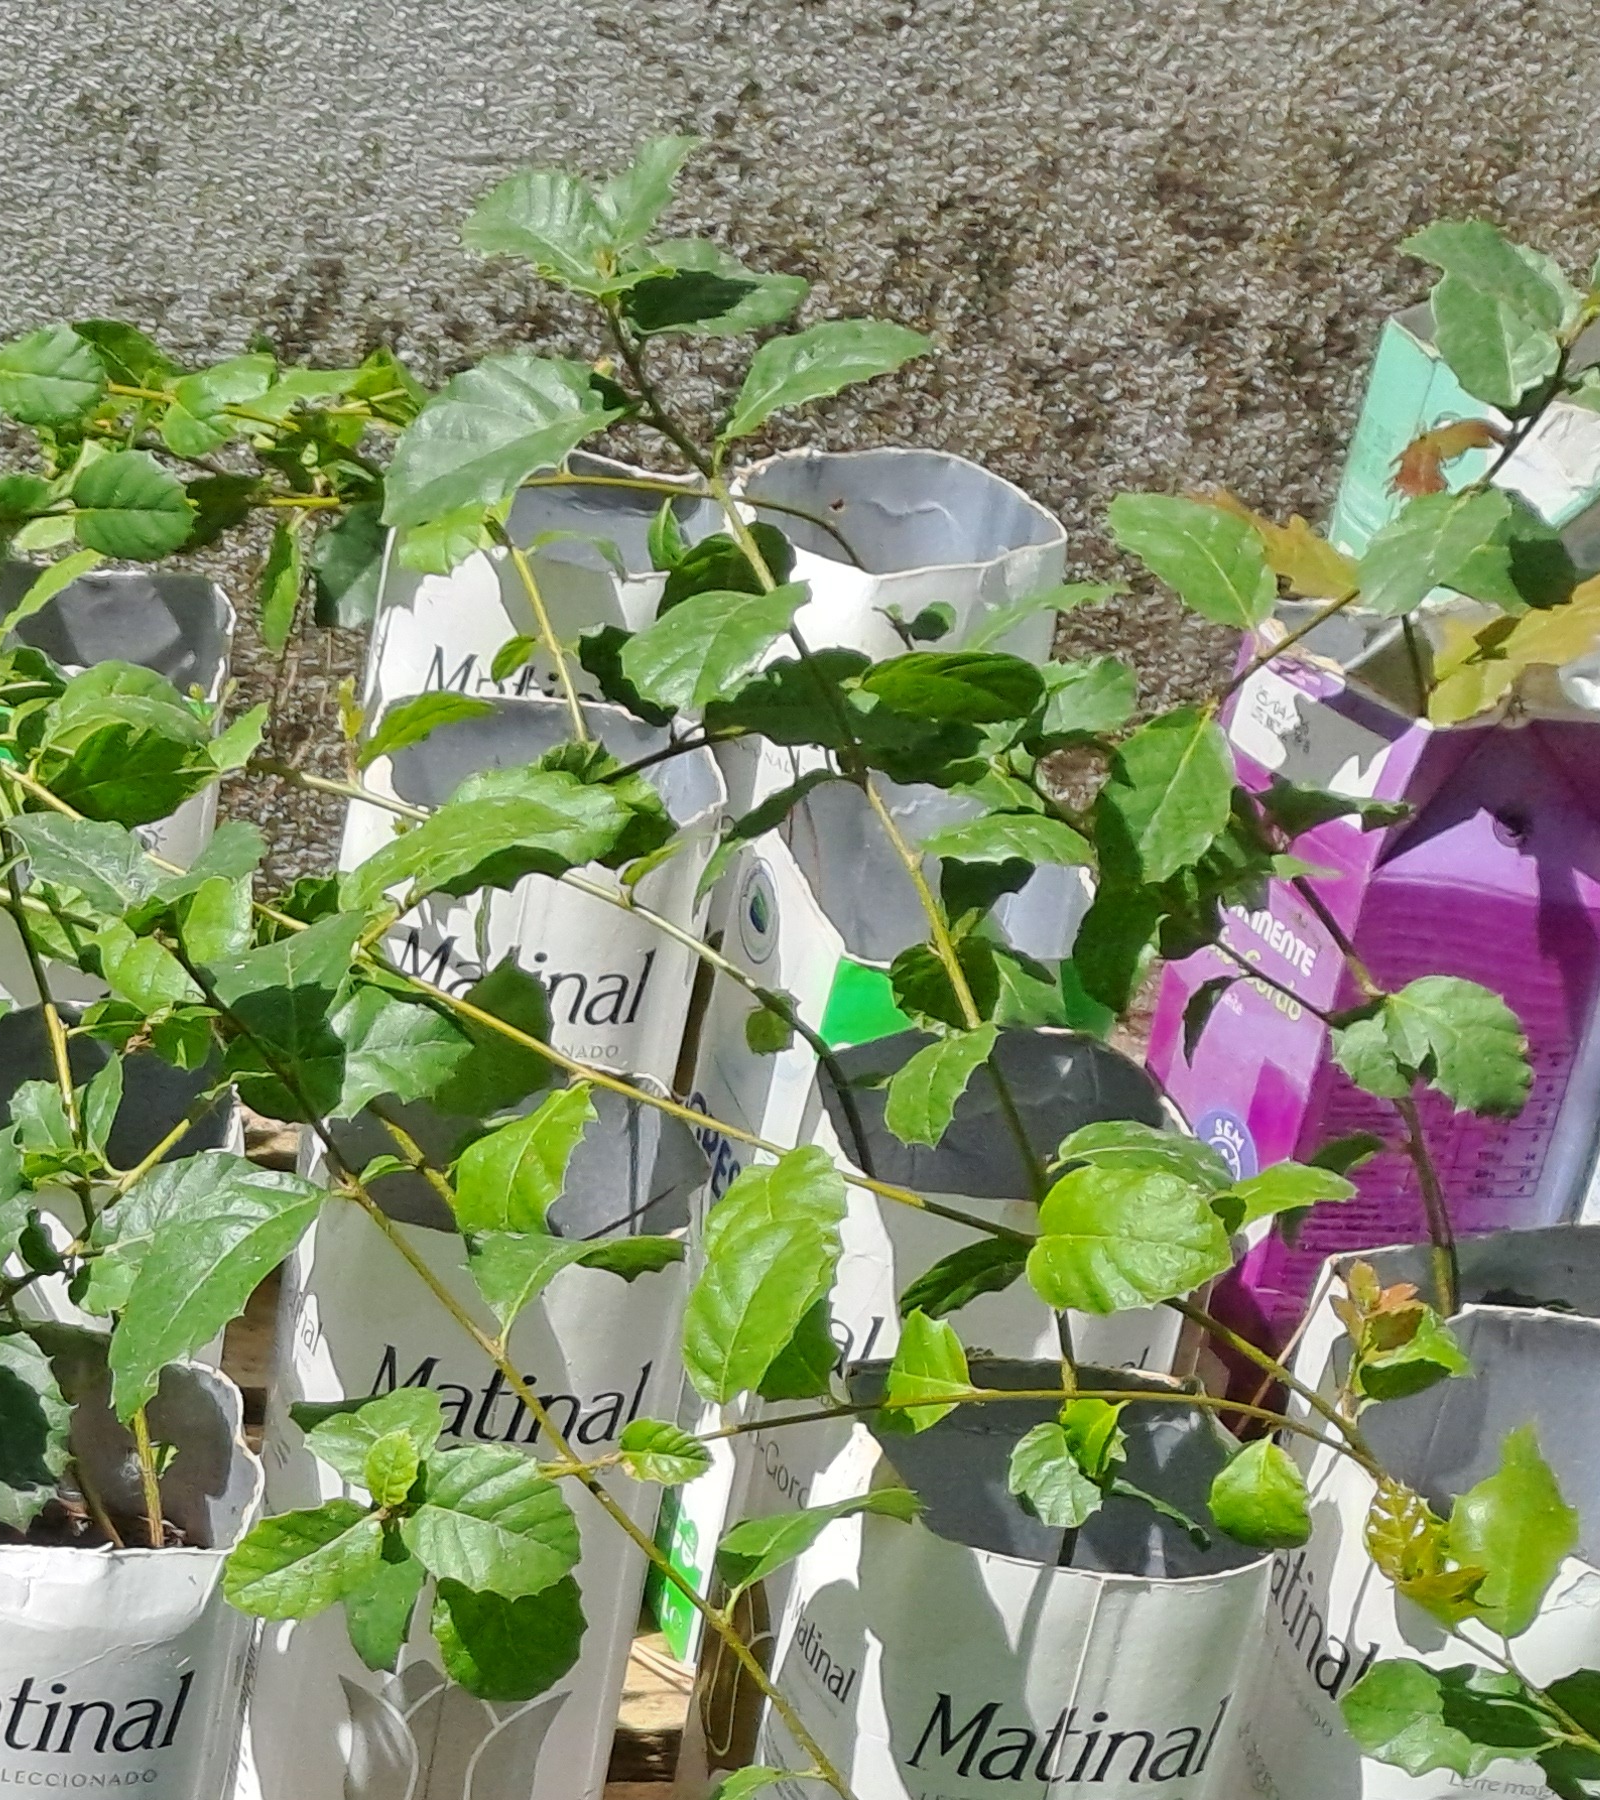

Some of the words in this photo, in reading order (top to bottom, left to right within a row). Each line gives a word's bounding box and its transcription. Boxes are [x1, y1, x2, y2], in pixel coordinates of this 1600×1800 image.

[796, 1615, 856, 1704] atinal
[1271, 1549, 1381, 1701] atinal
[906, 1691, 1228, 1787] Matinal
